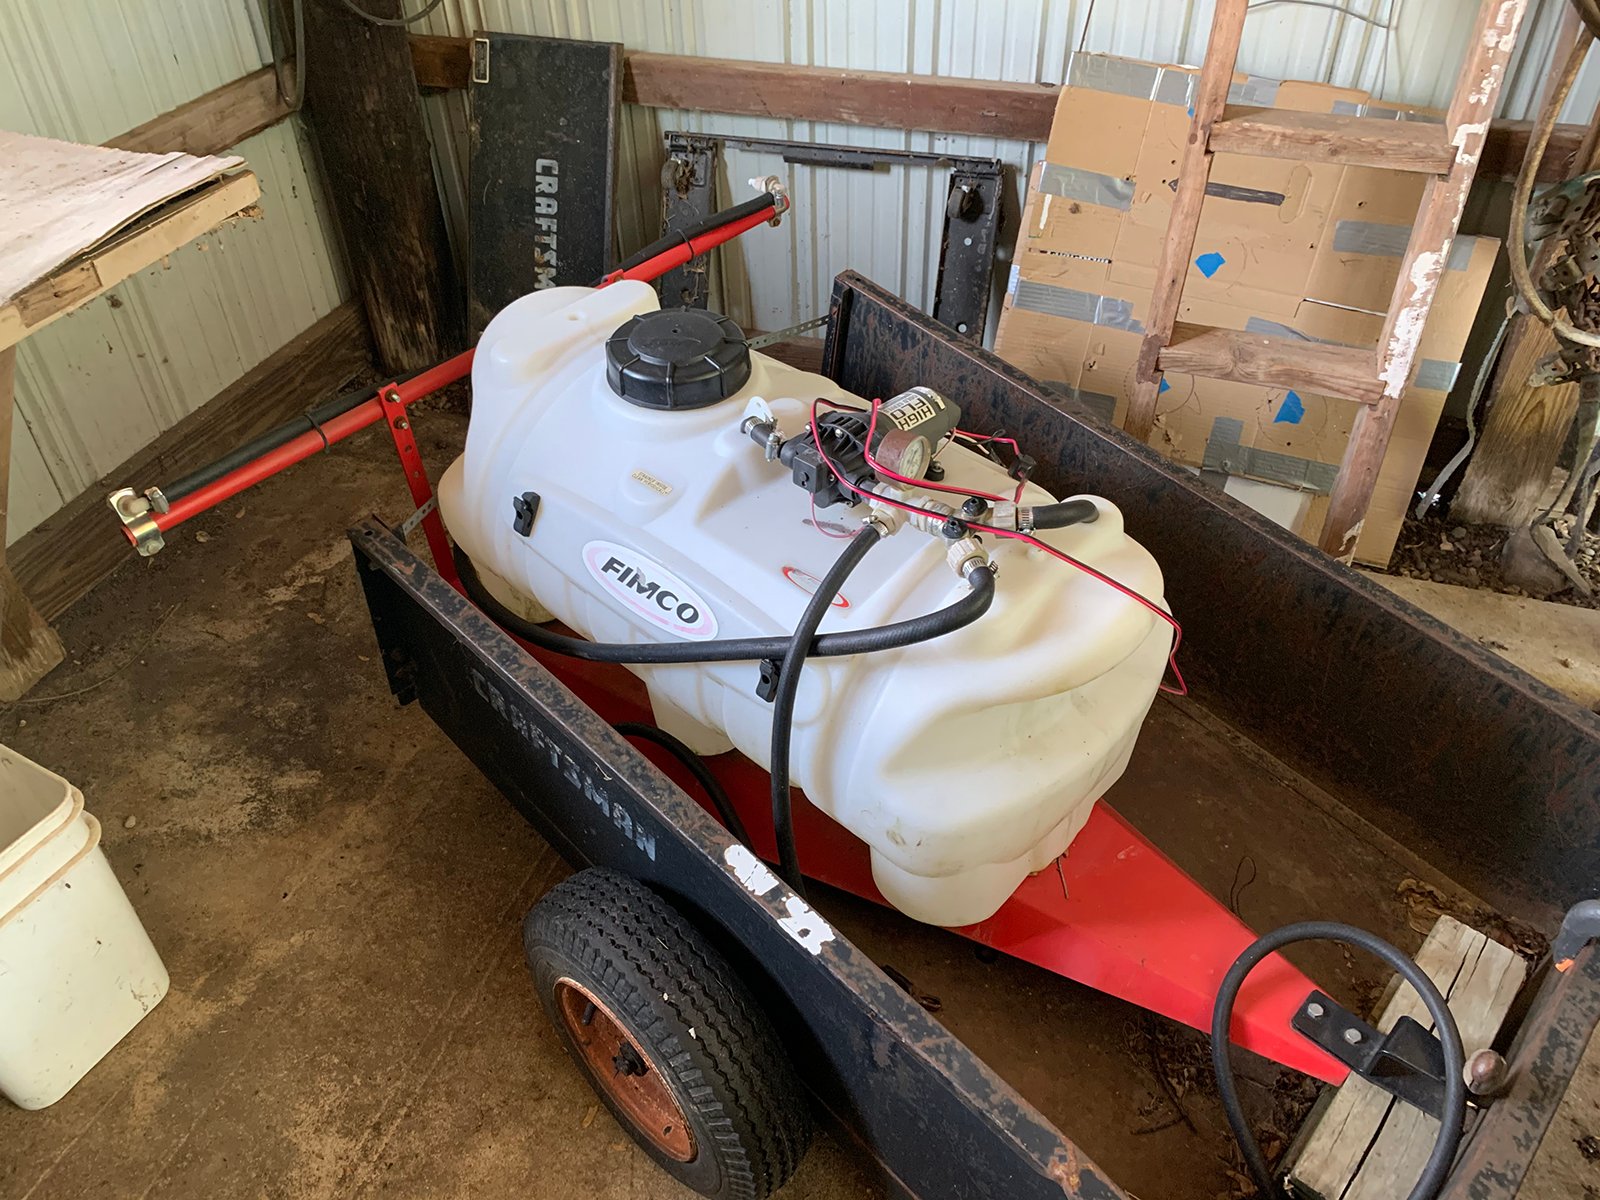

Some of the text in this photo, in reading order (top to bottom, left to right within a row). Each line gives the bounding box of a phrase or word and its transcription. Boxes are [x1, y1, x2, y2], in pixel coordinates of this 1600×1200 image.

[890, 397, 926, 420] FLO
[898, 405, 933, 431] HIGH
[600, 556, 700, 624] FIMCO
[471, 668, 656, 862] CRAFTSMAN
